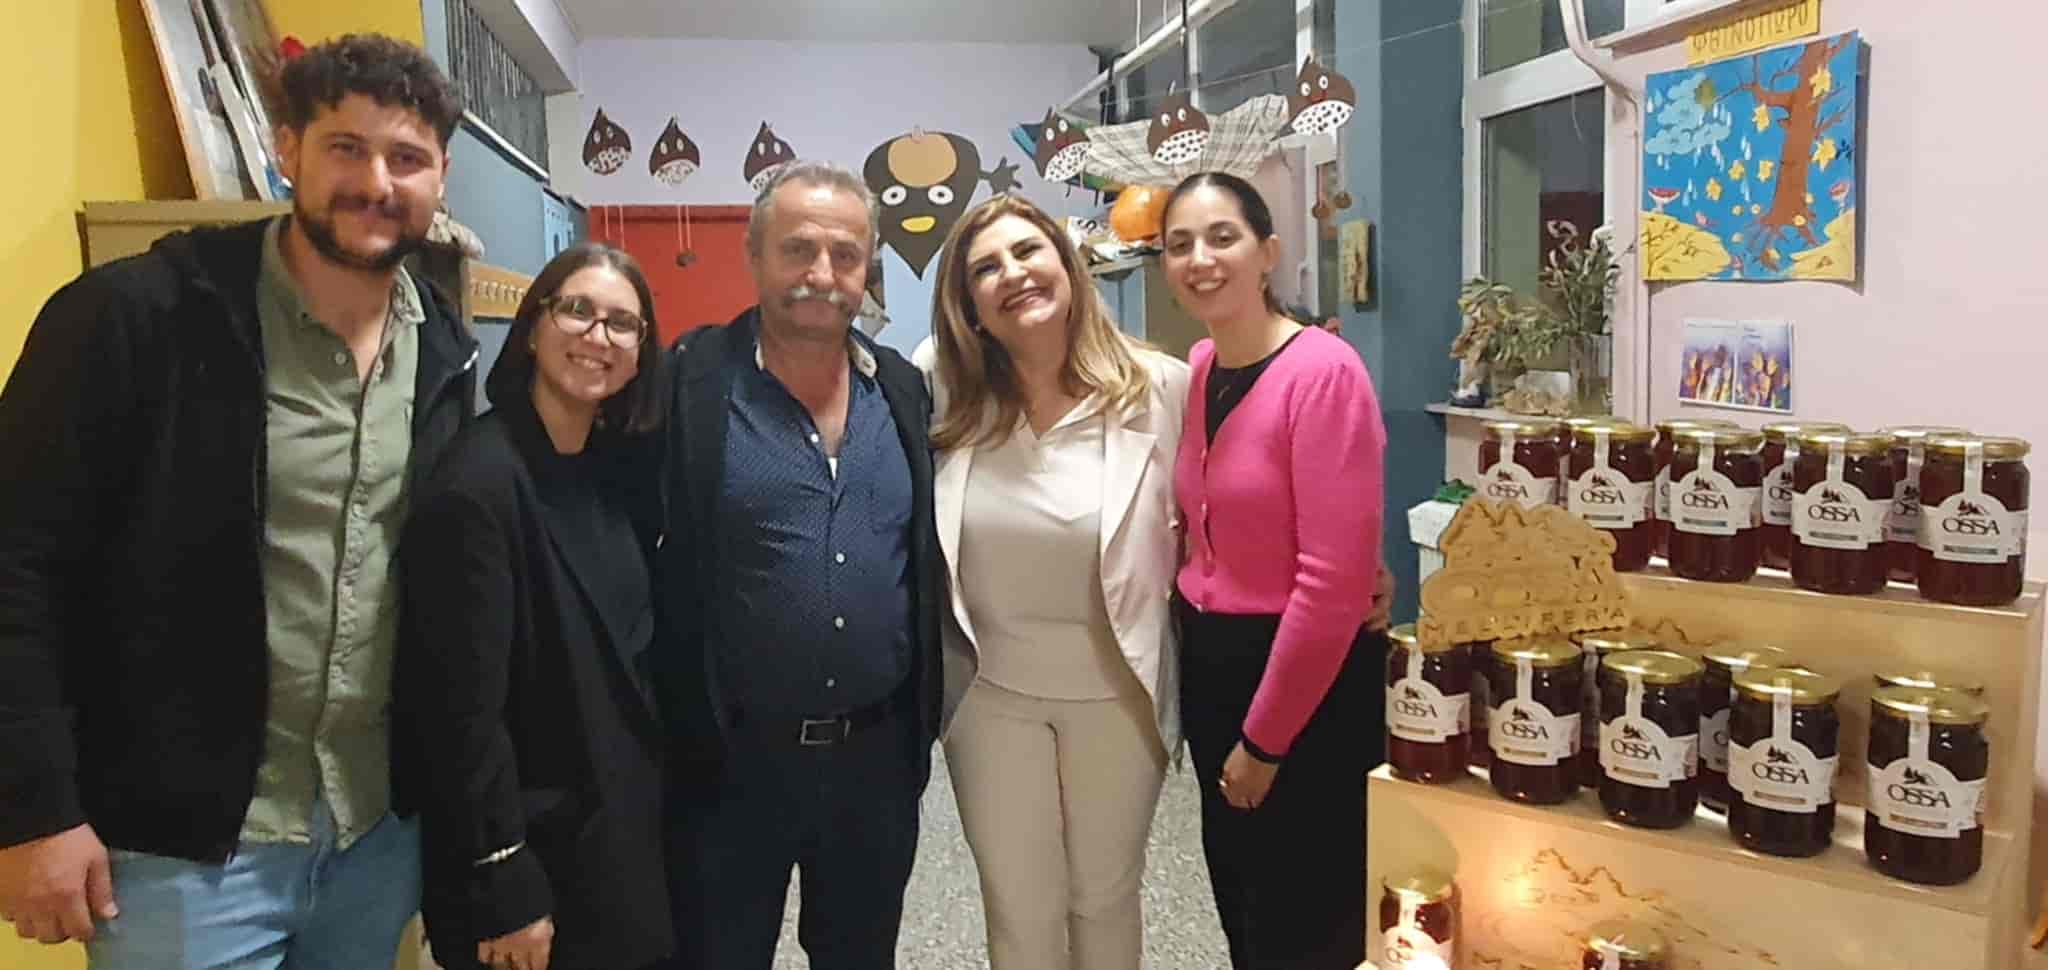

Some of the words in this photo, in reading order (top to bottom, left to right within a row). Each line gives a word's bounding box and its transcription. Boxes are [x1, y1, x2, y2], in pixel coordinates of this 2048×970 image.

[1487, 482, 1529, 499] OSSA
[1580, 488, 1626, 505] OSSA
[1682, 491, 1729, 510] OSSA
[1808, 503, 1861, 523] OSSA
[1942, 517, 2000, 536] OSSA
[1394, 700, 1438, 719] OSSA
[1502, 721, 1550, 740] OSSA
[1611, 738, 1662, 761] OSSA
[1752, 762, 1810, 785] OSSA
[1888, 784, 1951, 809] OSSA
